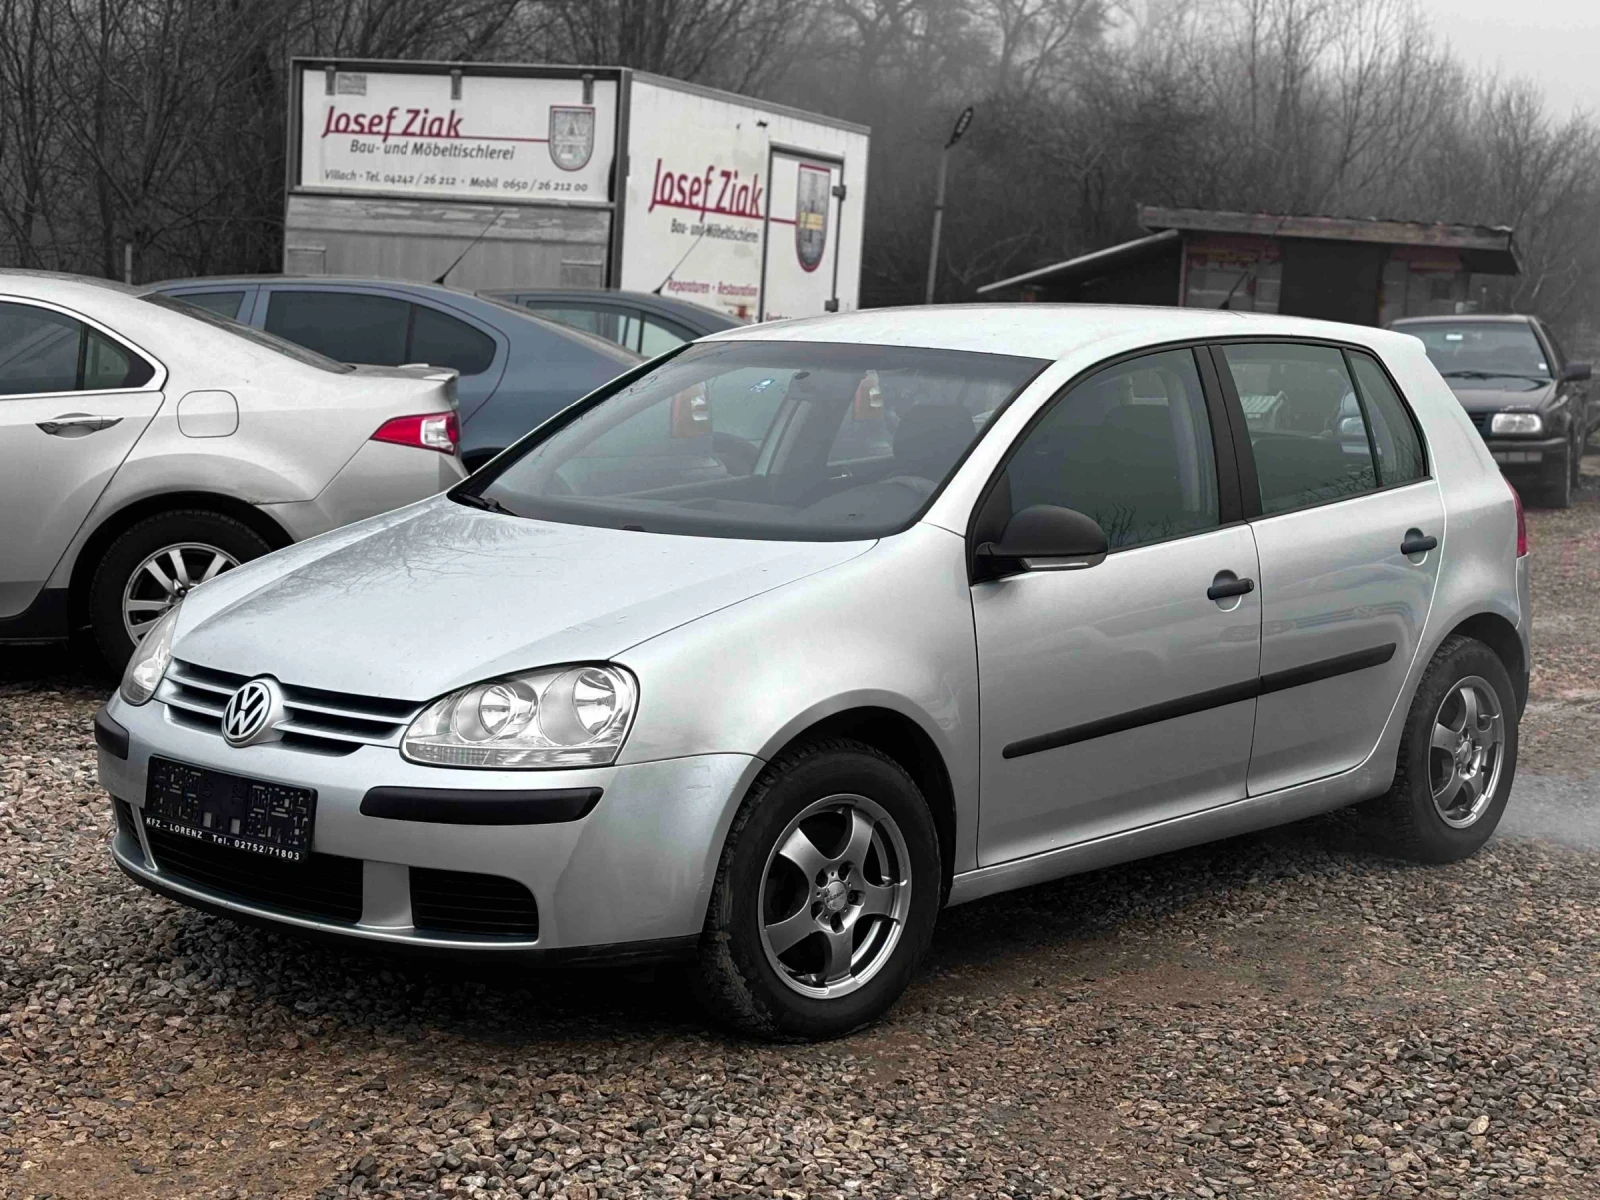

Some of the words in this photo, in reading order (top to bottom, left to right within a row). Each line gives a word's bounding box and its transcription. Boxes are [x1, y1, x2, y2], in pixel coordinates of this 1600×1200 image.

[321, 105, 399, 143] Josef
[401, 108, 463, 137] Ziak
[350, 139, 380, 154] Bau-
[383, 141, 409, 155] und
[411, 142, 516, 160] Möbeltischlerei
[325, 169, 357, 181] Villach
[469, 177, 499, 189] Mobil
[648, 158, 715, 223] Josef
[716, 169, 763, 217] Ziak
[212, 834, 230, 845] Tel.
[234, 839, 300, 861] 02752/71803
